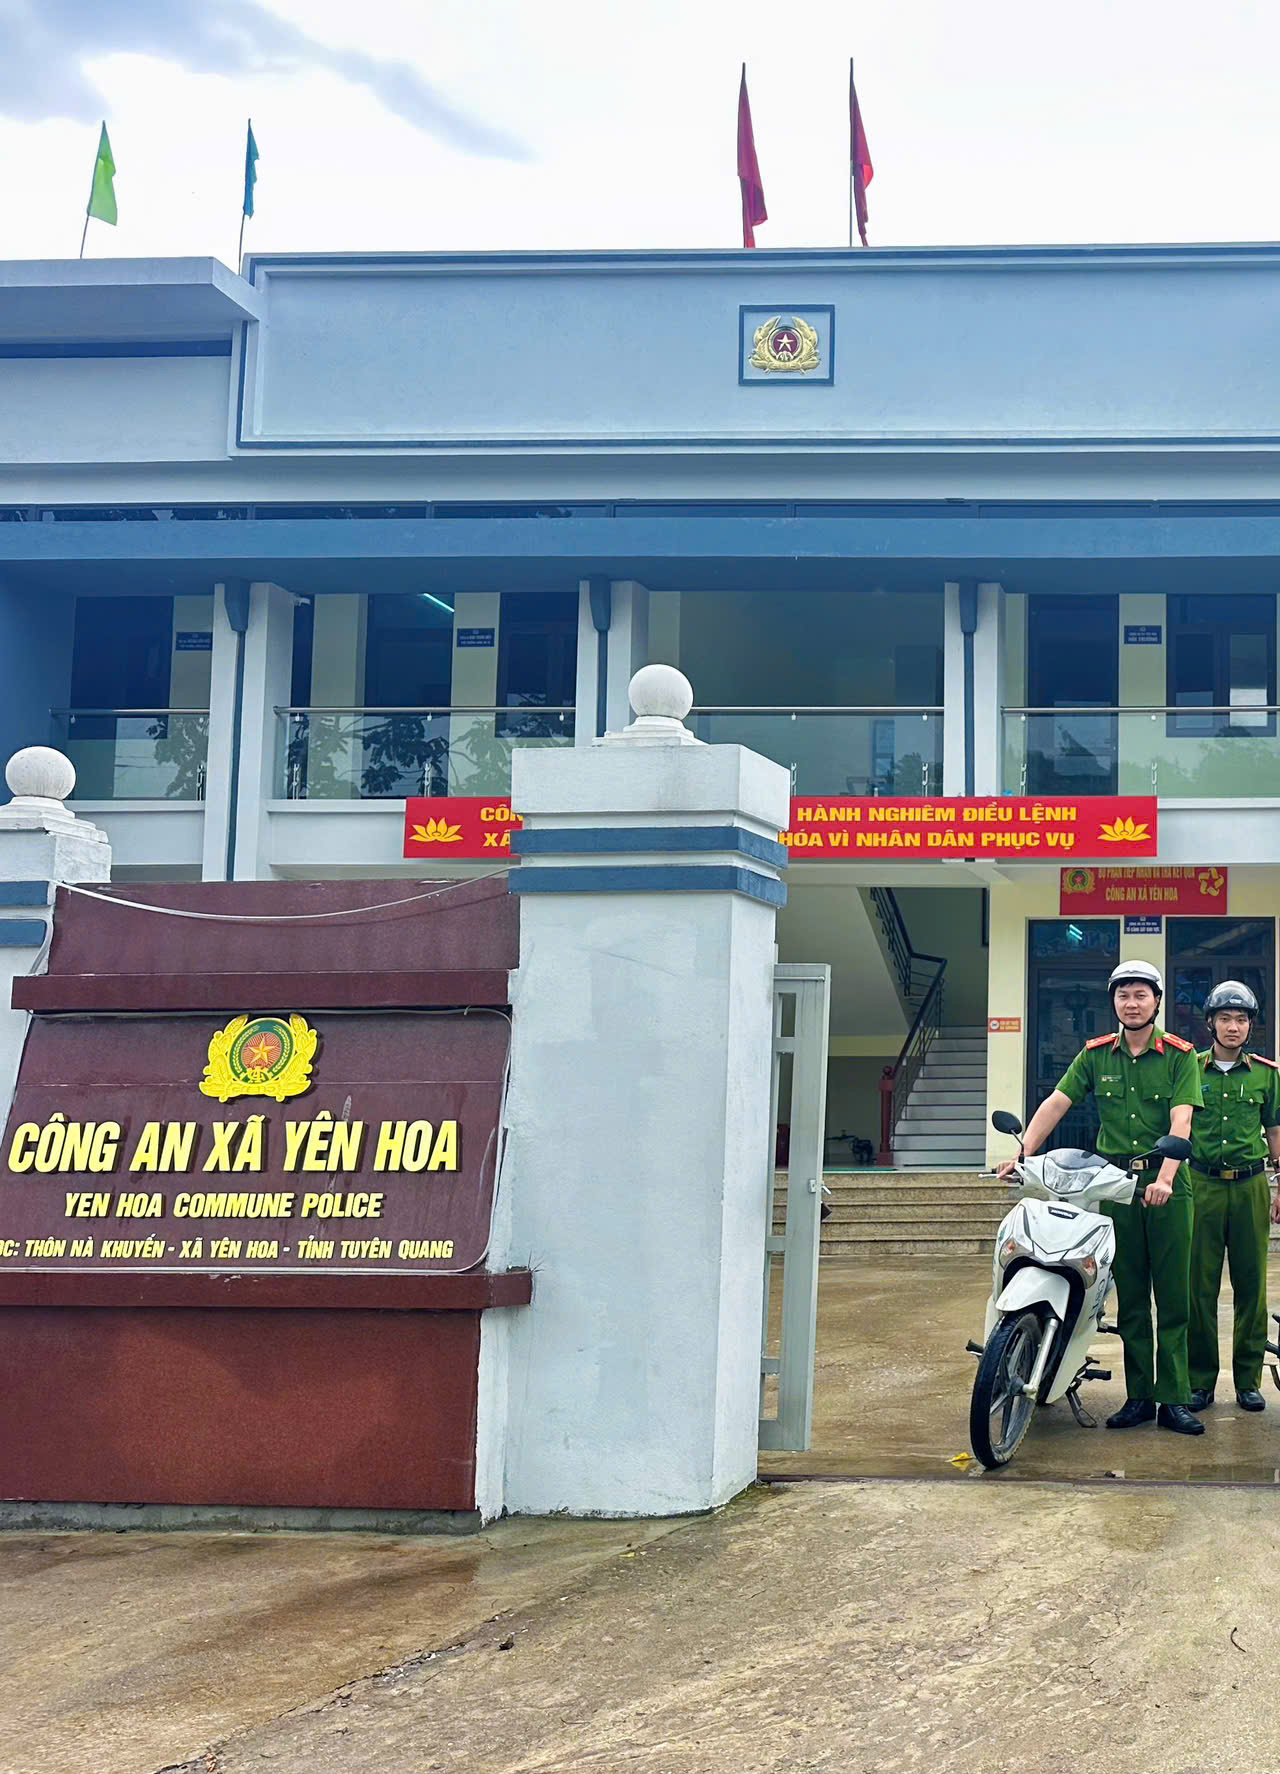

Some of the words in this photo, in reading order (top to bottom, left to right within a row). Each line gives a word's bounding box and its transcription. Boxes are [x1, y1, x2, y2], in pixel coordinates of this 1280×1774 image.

[797, 804, 861, 822] HÀNH
[868, 804, 956, 822] NGHIÊM
[962, 801, 1013, 822] ĐIỀU
[1019, 803, 1077, 824] LỆNH
[828, 829, 849, 847] VÌ
[856, 829, 921, 847] NHÂN
[927, 829, 974, 847] DÂN
[981, 831, 1040, 850] PHỤC
[1045, 831, 1075, 850] VỤ
[1127, 887, 1136, 901] AN
[8, 1112, 121, 1173] CÔNG
[129, 1122, 196, 1172] AN
[202, 1114, 265, 1172] XÃ
[283, 1110, 364, 1172] YÊN
[373, 1120, 458, 1172] HOA
[65, 1192, 110, 1217] YEN
[116, 1192, 163, 1217] HOA
[173, 1192, 294, 1218] COMMUNE
[301, 1192, 383, 1218] POLICE
[25, 1236, 66, 1257] THÔN
[69, 1236, 94, 1257] NÀ
[100, 1233, 165, 1258] KHUYẾN
[179, 1236, 203, 1258] XÃ
[210, 1236, 242, 1259] YÊN
[246, 1240, 279, 1259] HOA
[297, 1235, 334, 1259] TỈNH
[341, 1236, 392, 1259] TUYÊN
[398, 1239, 454, 1260] QUANG
